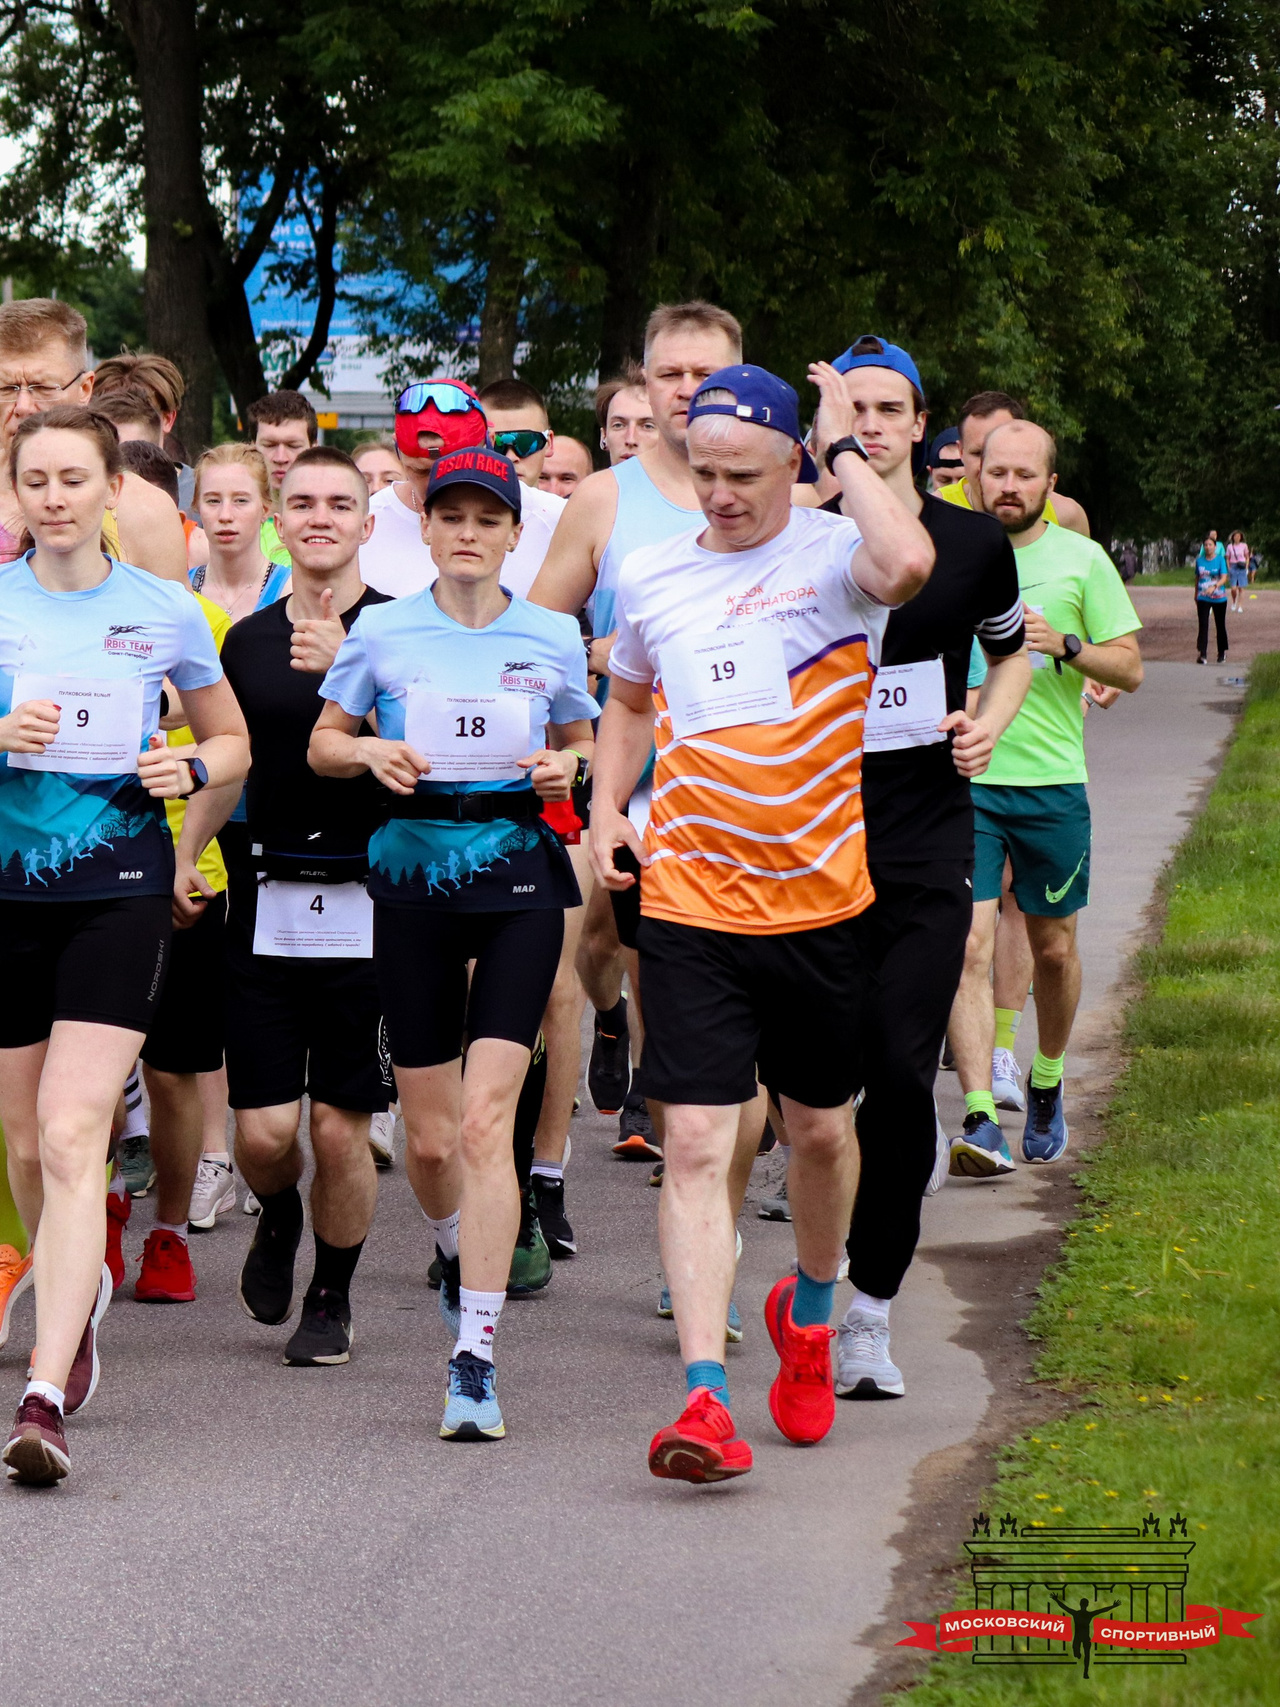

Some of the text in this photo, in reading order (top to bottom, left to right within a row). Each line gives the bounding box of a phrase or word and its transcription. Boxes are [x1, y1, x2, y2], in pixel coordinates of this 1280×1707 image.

[435, 452, 509, 483] BISON RACE
[104, 638, 154, 654] IRBIS TEAM
[710, 660, 736, 682] 19
[500, 675, 546, 691] IRBIS TEAM
[877, 686, 908, 709] 20
[76, 709, 90, 728] 9
[455, 716, 486, 738] 18
[119, 871, 143, 880] MAD
[512, 884, 536, 893] MAD
[309, 894, 325, 915] 4
[147, 939, 165, 1002] NORDSKI
